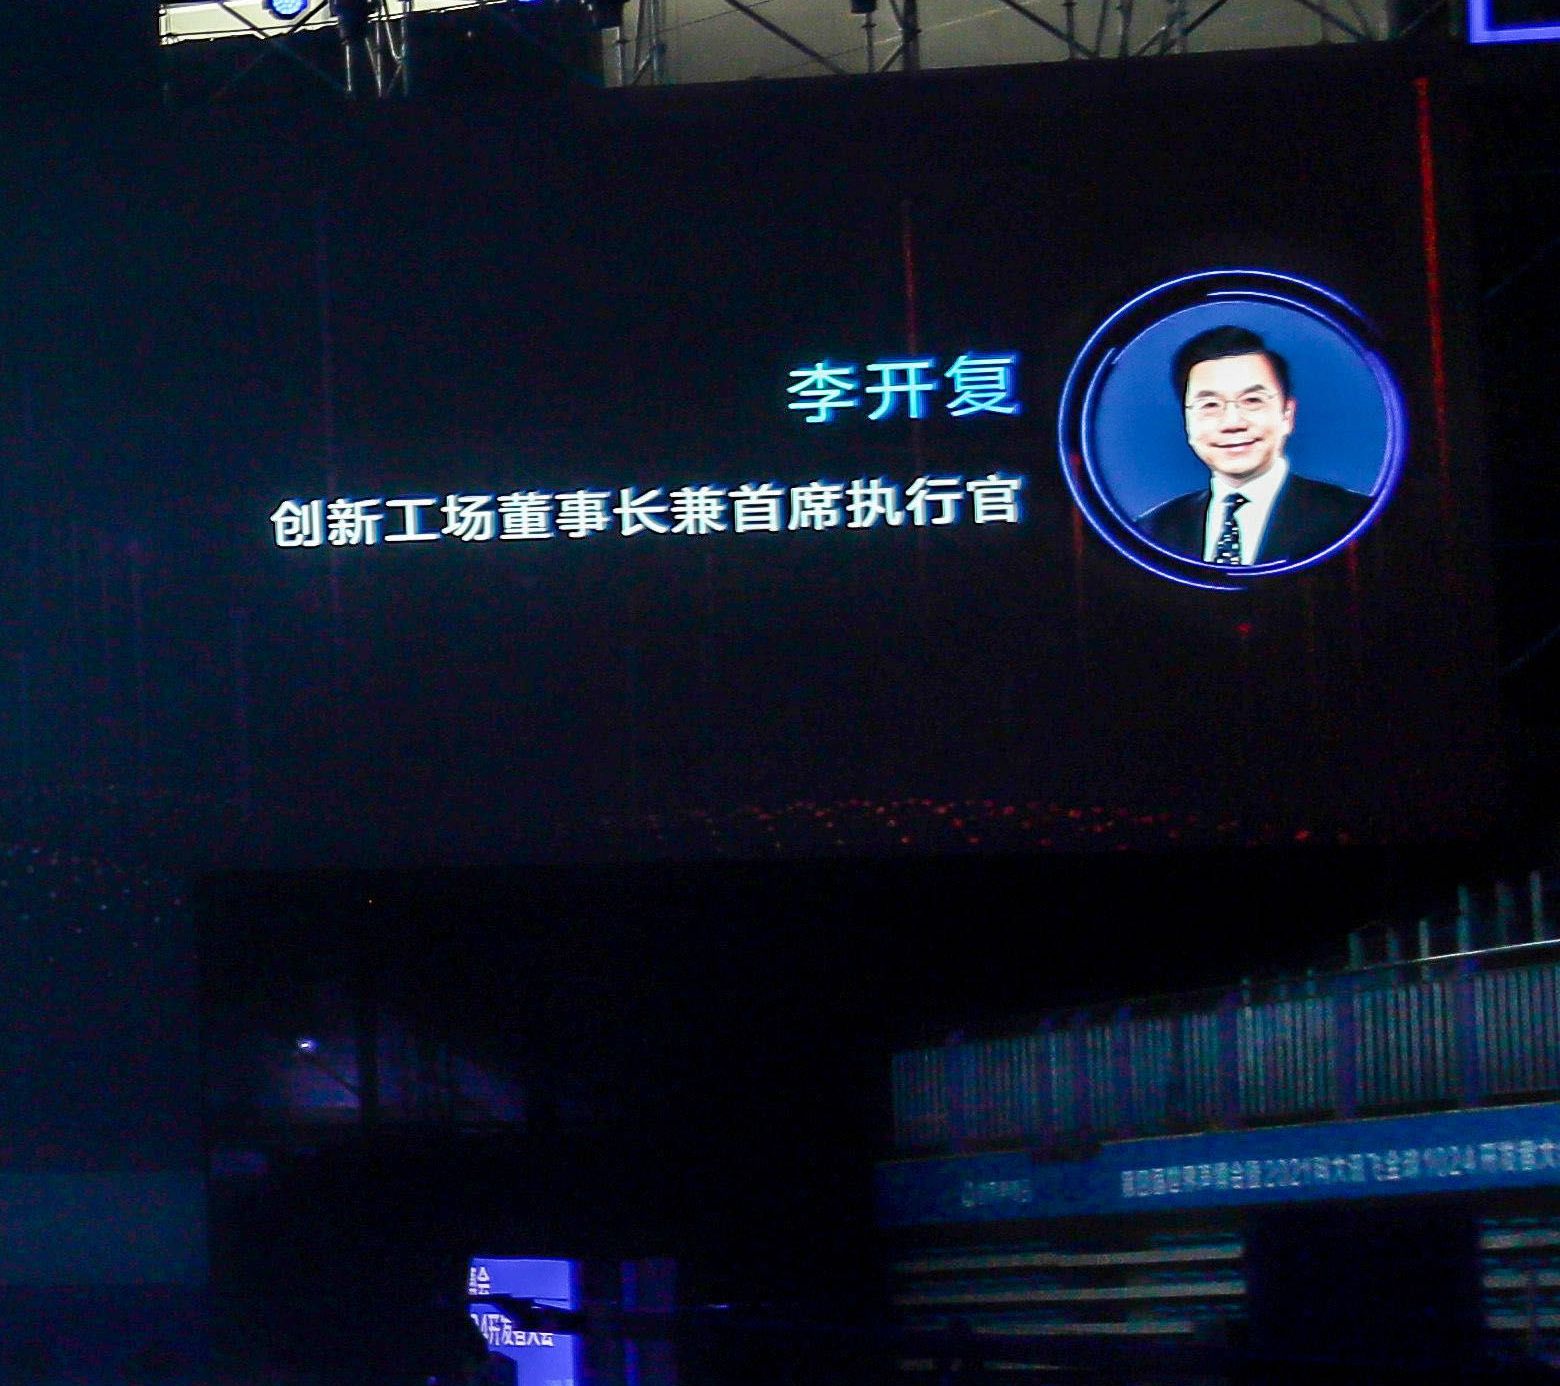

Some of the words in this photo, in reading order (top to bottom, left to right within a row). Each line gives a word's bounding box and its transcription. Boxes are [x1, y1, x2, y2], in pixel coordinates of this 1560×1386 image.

[786, 353, 1020, 425] 李开复
[269, 473, 1023, 549] 创新工场董事长兼首席执行官
